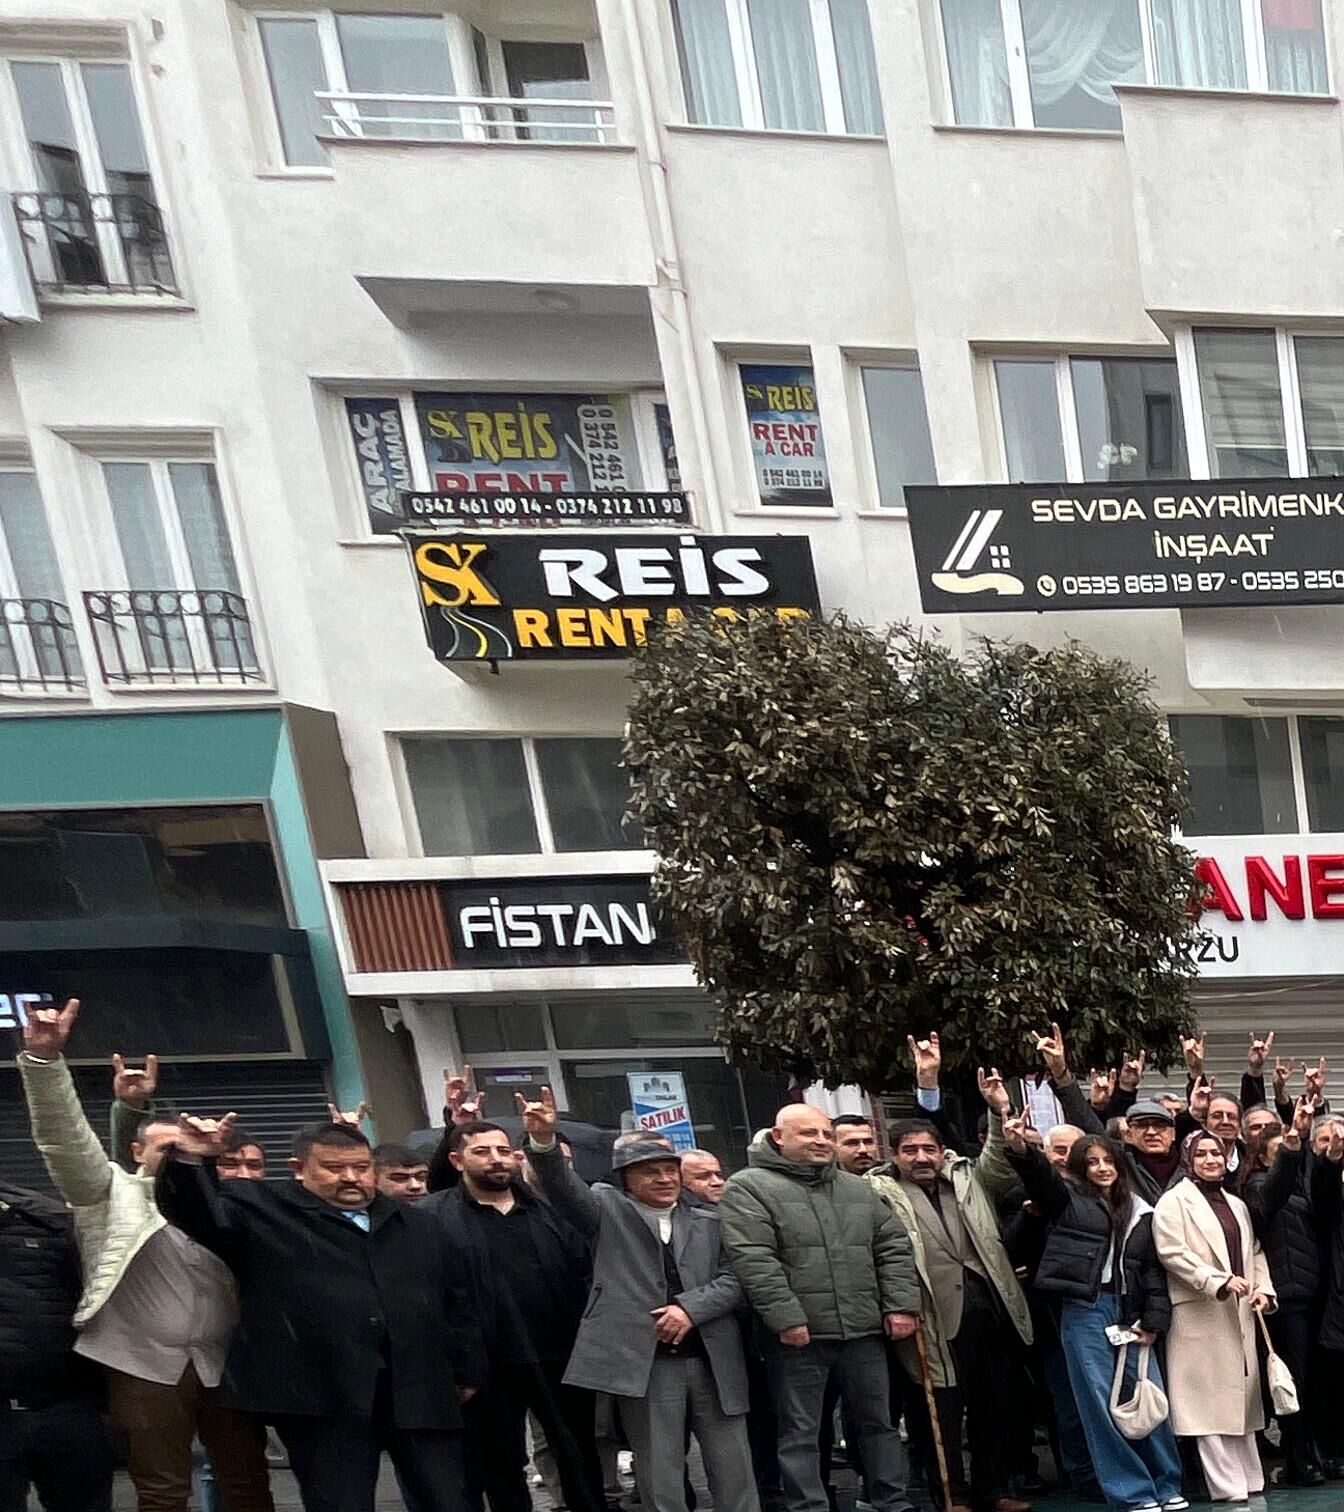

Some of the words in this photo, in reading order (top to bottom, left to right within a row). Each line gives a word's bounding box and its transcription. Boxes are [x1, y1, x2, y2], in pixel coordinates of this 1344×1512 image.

[466, 402, 558, 464] REİS
[753, 422, 818, 441] RENT
[765, 441, 776, 456] A
[780, 442, 814, 457] CAR
[411, 498, 455, 514] 0542
[459, 498, 488, 514] 461
[494, 498, 516, 514] 00
[523, 498, 542, 514] 14
[556, 498, 598, 514] 0374
[601, 498, 633, 514] 212
[1031, 498, 1147, 522] SEVDA
[1153, 529, 1274, 564] İNŞAAT
[538, 536, 770, 602] REİS
[1063, 575, 1121, 594] 0535
[1124, 574, 1169, 593] 863
[1171, 573, 1194, 593] 19
[1197, 573, 1225, 592] 87
[1241, 571, 1299, 591] 0535
[512, 608, 651, 648] RENT
[459, 897, 657, 949] FİSTAN
[640, 1106, 687, 1131] SATILIK
